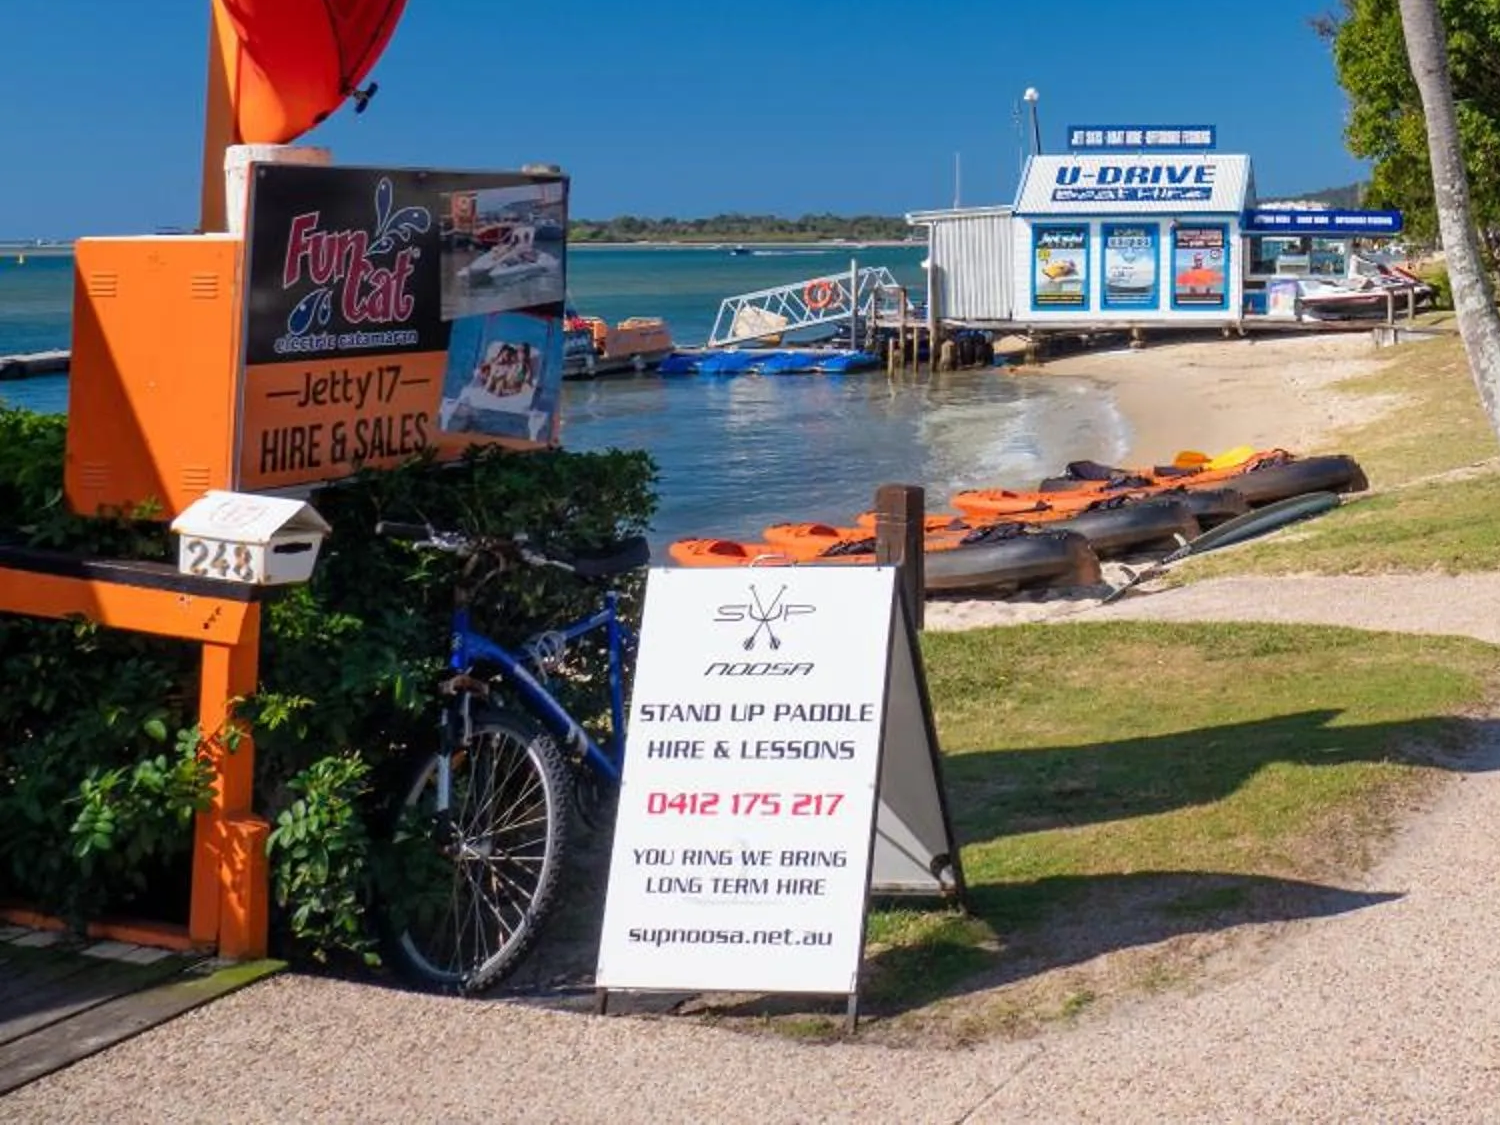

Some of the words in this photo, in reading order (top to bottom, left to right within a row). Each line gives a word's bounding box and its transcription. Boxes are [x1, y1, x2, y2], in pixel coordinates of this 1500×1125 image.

[1055, 164, 1217, 186] U-DRIVE
[282, 210, 369, 290] Fun
[342, 247, 415, 324] Cat
[273, 332, 336, 354] electric
[337, 329, 419, 348] catamaran
[297, 371, 373, 409] Jetty
[377, 364, 402, 402] 17
[260, 423, 323, 475] HIRE
[330, 420, 347, 465] &
[353, 412, 429, 461] SALES
[186, 538, 255, 581] 248
[713, 603, 816, 623] SUP
[704, 661, 815, 677] NOOSA
[639, 702, 721, 723] STAND
[730, 703, 765, 723] UP
[773, 702, 875, 723] PADDLE
[647, 739, 706, 760] HIRE
[712, 740, 731, 760] &
[740, 740, 856, 761] LESSONS
[647, 791, 719, 816] 0412
[731, 792, 781, 817] 175
[791, 793, 844, 817] 217
[633, 848, 676, 867] YOU
[681, 849, 733, 867] RING
[741, 850, 773, 868] WE
[779, 850, 848, 869] BRING
[645, 876, 702, 895] LONG
[711, 877, 769, 896] TERM
[776, 877, 827, 897] HIRE
[628, 926, 833, 948] supnoosa.net.au
